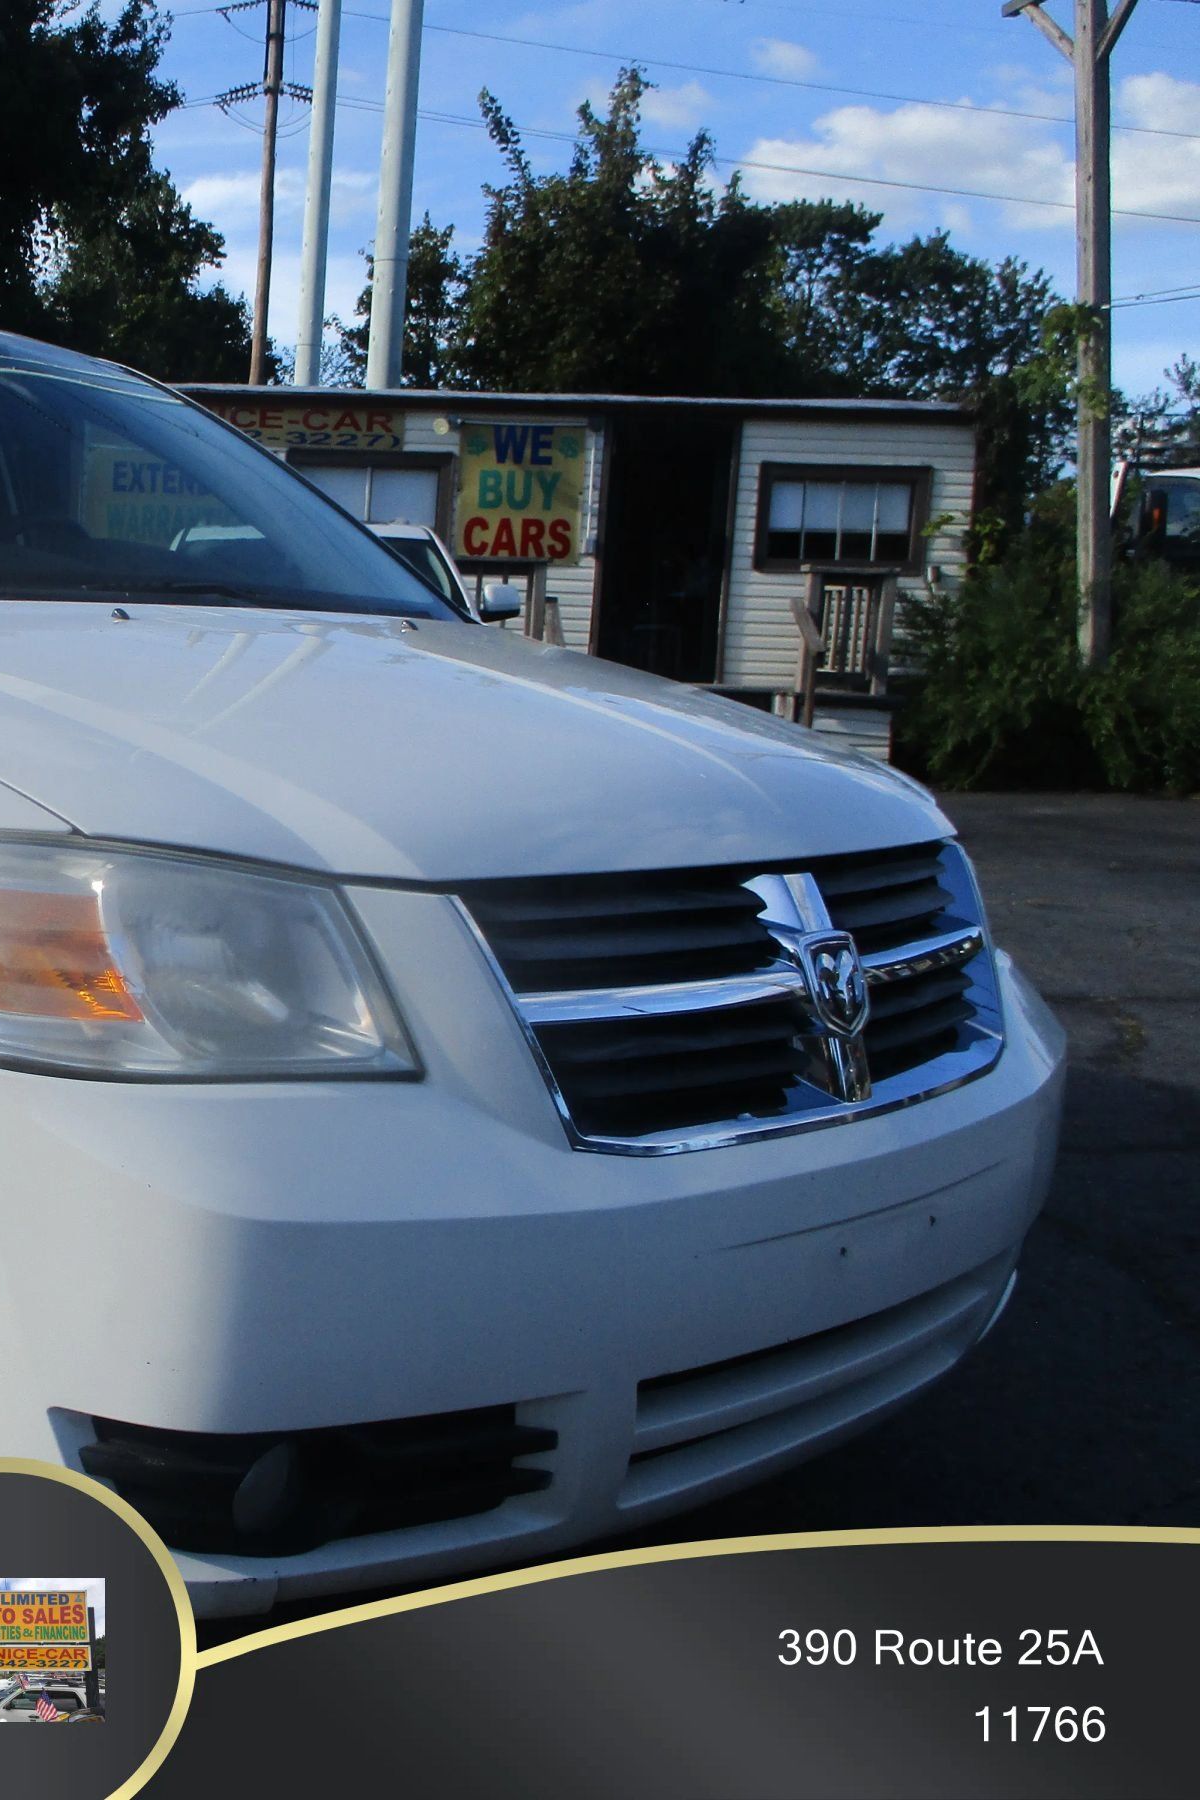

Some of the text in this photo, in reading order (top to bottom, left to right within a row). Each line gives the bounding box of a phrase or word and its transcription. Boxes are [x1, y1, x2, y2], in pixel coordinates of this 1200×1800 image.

[211, 403, 394, 433] ICE-CAR
[493, 426, 554, 465] WE
[112, 461, 209, 494] EXTEN
[478, 470, 562, 511] BUY
[463, 517, 571, 559] CARS
